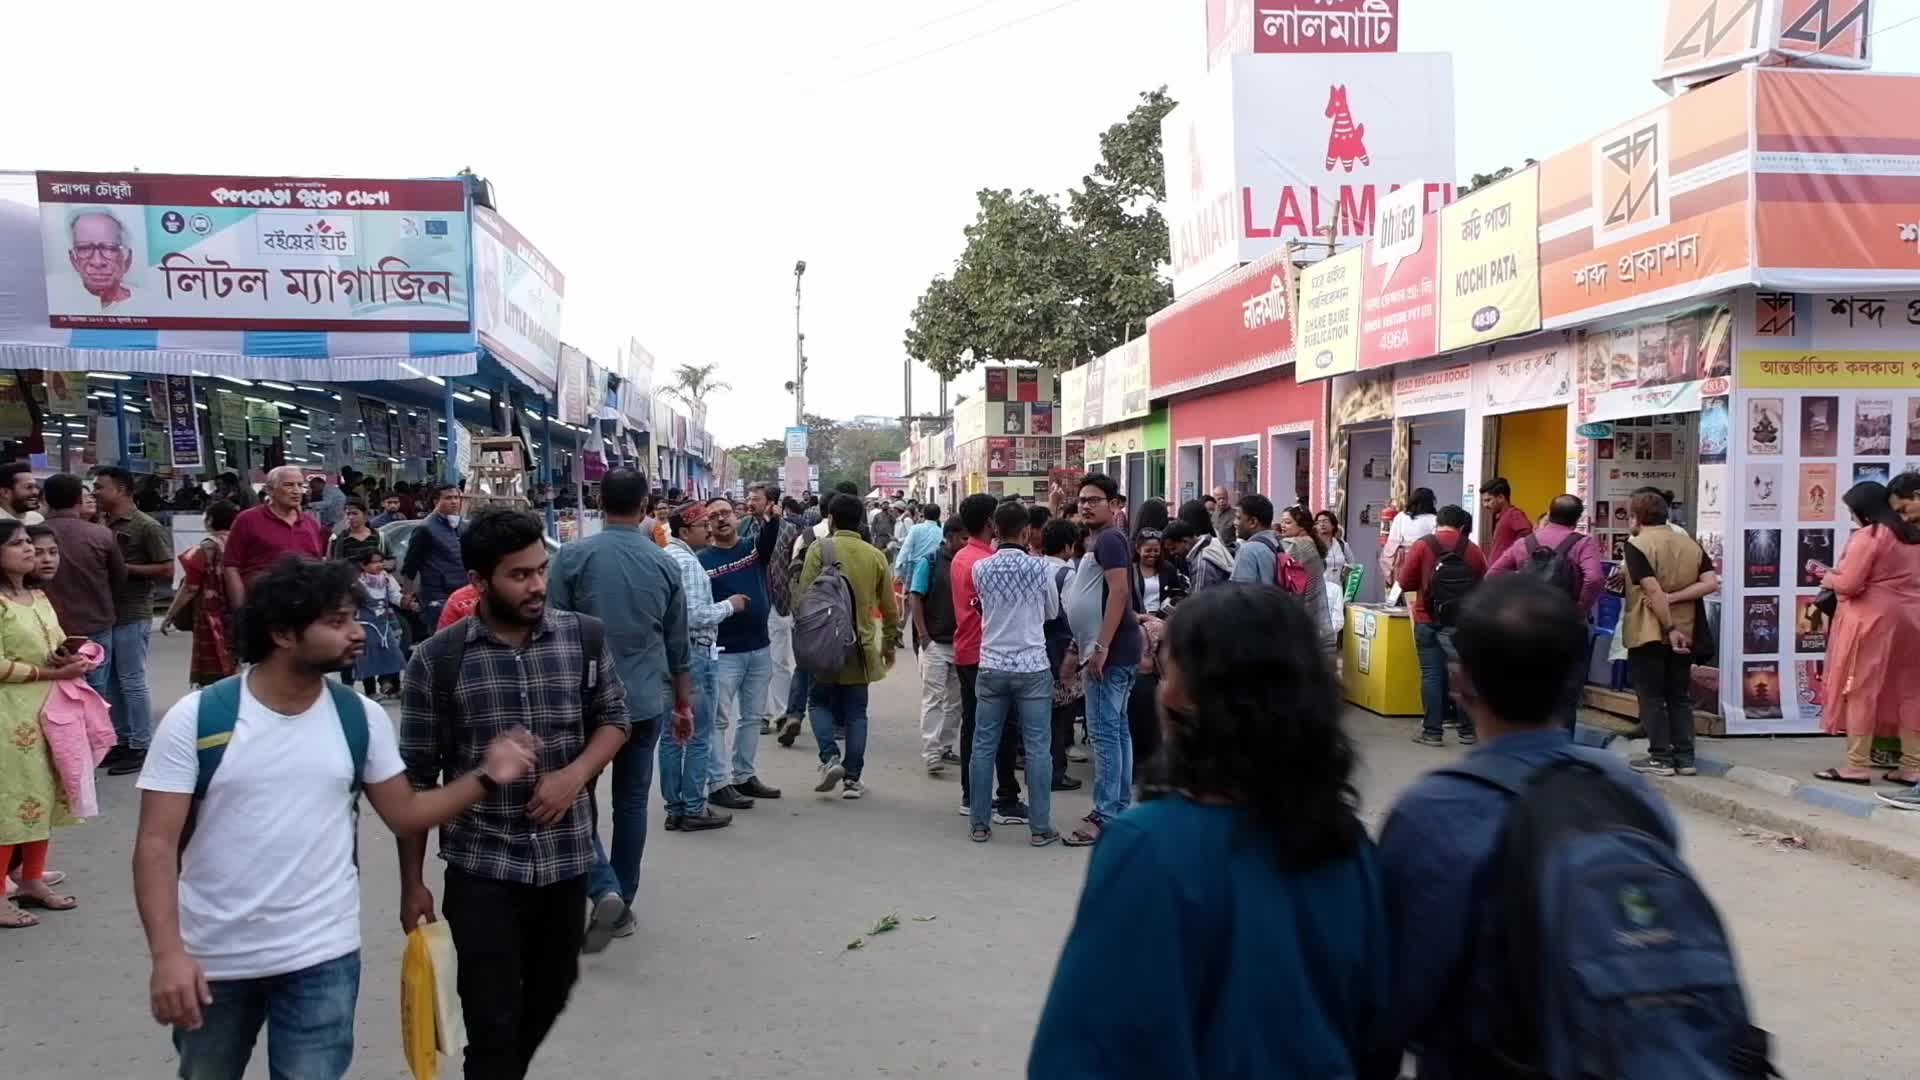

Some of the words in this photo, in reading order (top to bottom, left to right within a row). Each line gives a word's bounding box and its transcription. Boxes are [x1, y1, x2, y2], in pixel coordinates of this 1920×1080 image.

[1259, 0, 1393, 48] লালমাটি
[50, 182, 91, 196] রমাপদ
[95, 182, 132, 199] চৌধুরী
[1484, 202, 1512, 232] পাতা
[264, 230, 316, 251] বইয়ের
[319, 230, 348, 251] হাট
[158, 252, 270, 301] লিটল
[280, 256, 453, 305] ম্যাগাজিন
[1455, 263, 1487, 297] KOCHI
[1490, 253, 1518, 286] PATA
[1573, 262, 1607, 296] শব্দ
[1617, 233, 1701, 283] প্রকাশন
[1826, 296, 1888, 328] শব্দ
[1444, 368, 1470, 384] BOOKS
[1760, 356, 1838, 377] আন্তর্জাতিক
[1844, 360, 1905, 376] কলকাতা
